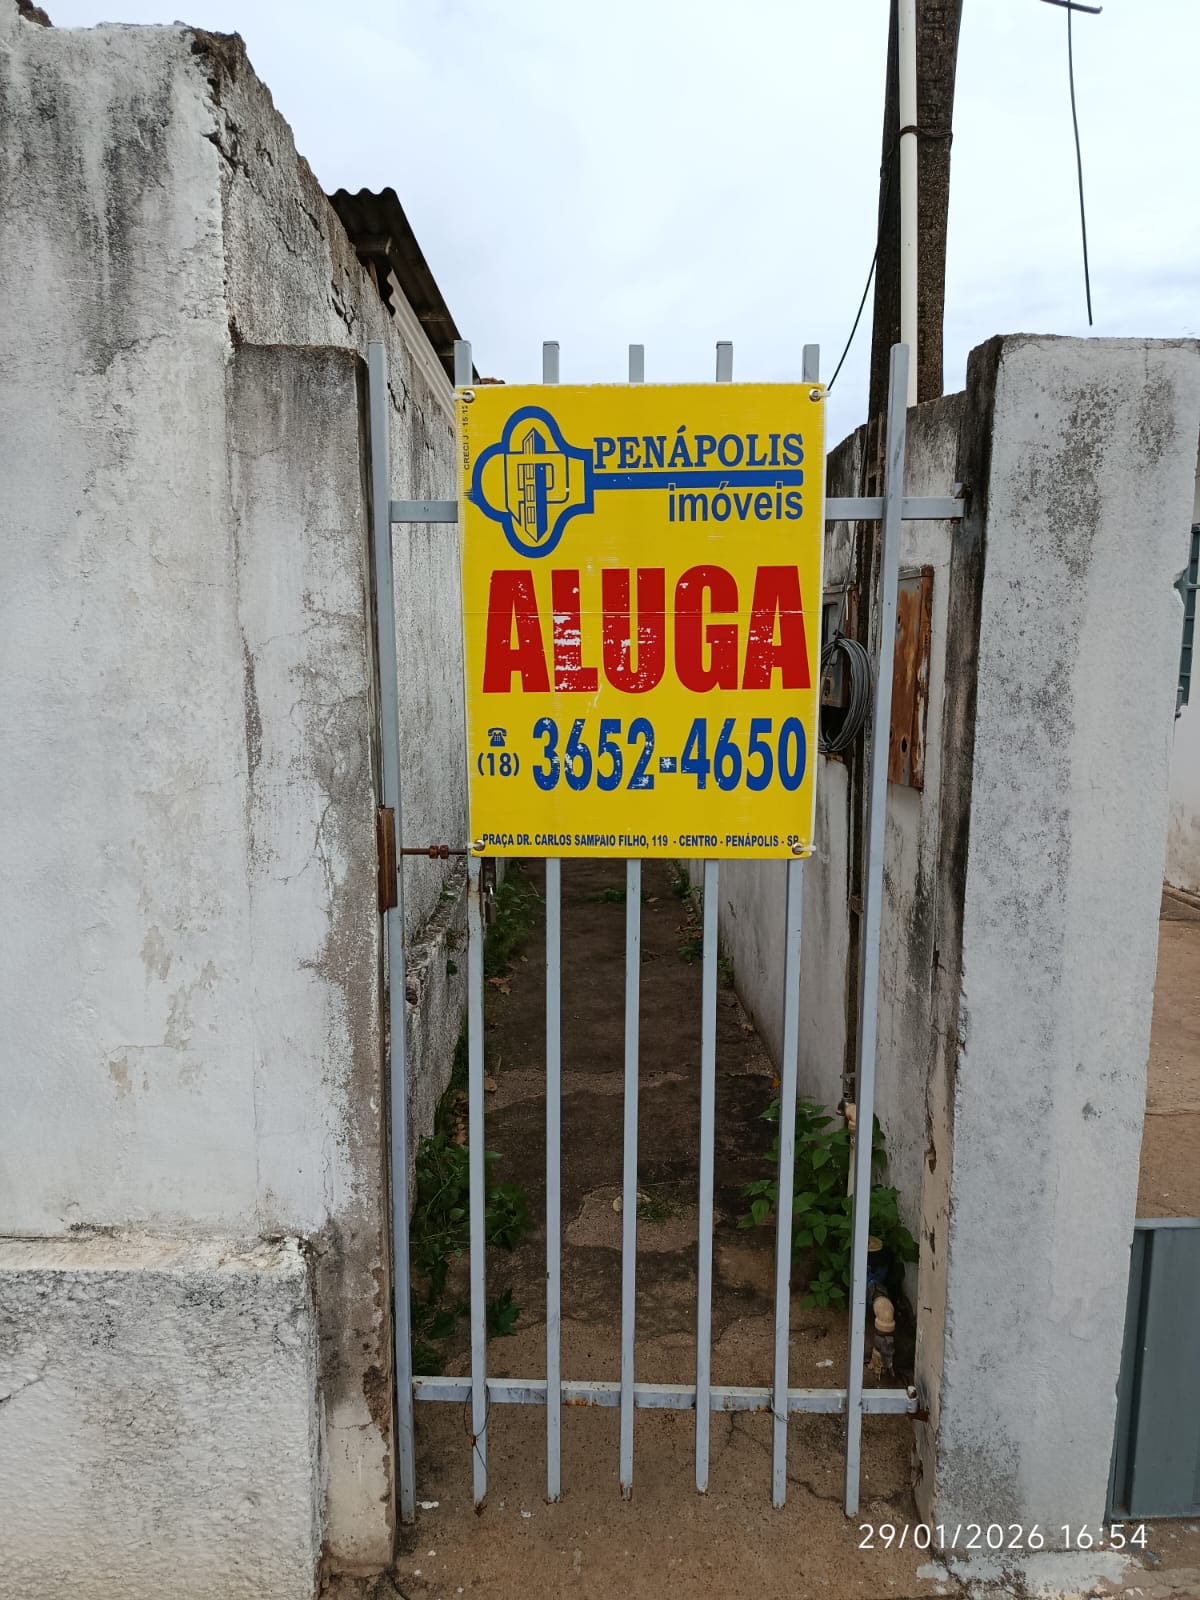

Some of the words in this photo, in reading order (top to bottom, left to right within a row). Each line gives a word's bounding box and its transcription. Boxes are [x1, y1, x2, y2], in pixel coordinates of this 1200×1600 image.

[593, 425, 804, 469] PENÁPOLIS
[669, 481, 803, 522] imóveis
[482, 564, 811, 694] ALUGA
[477, 752, 520, 777] (18)
[532, 716, 807, 792] 3652-4650
[483, 833, 514, 848] PRAÇA
[516, 834, 532, 846] DR.
[535, 834, 571, 846] CARLOS
[574, 834, 616, 847] SAMPAIO
[618, 835, 649, 848] FILHO,
[652, 835, 668, 847] 119
[679, 835, 718, 847] CENTRO
[725, 833, 779, 848] PENÁPOLIS
